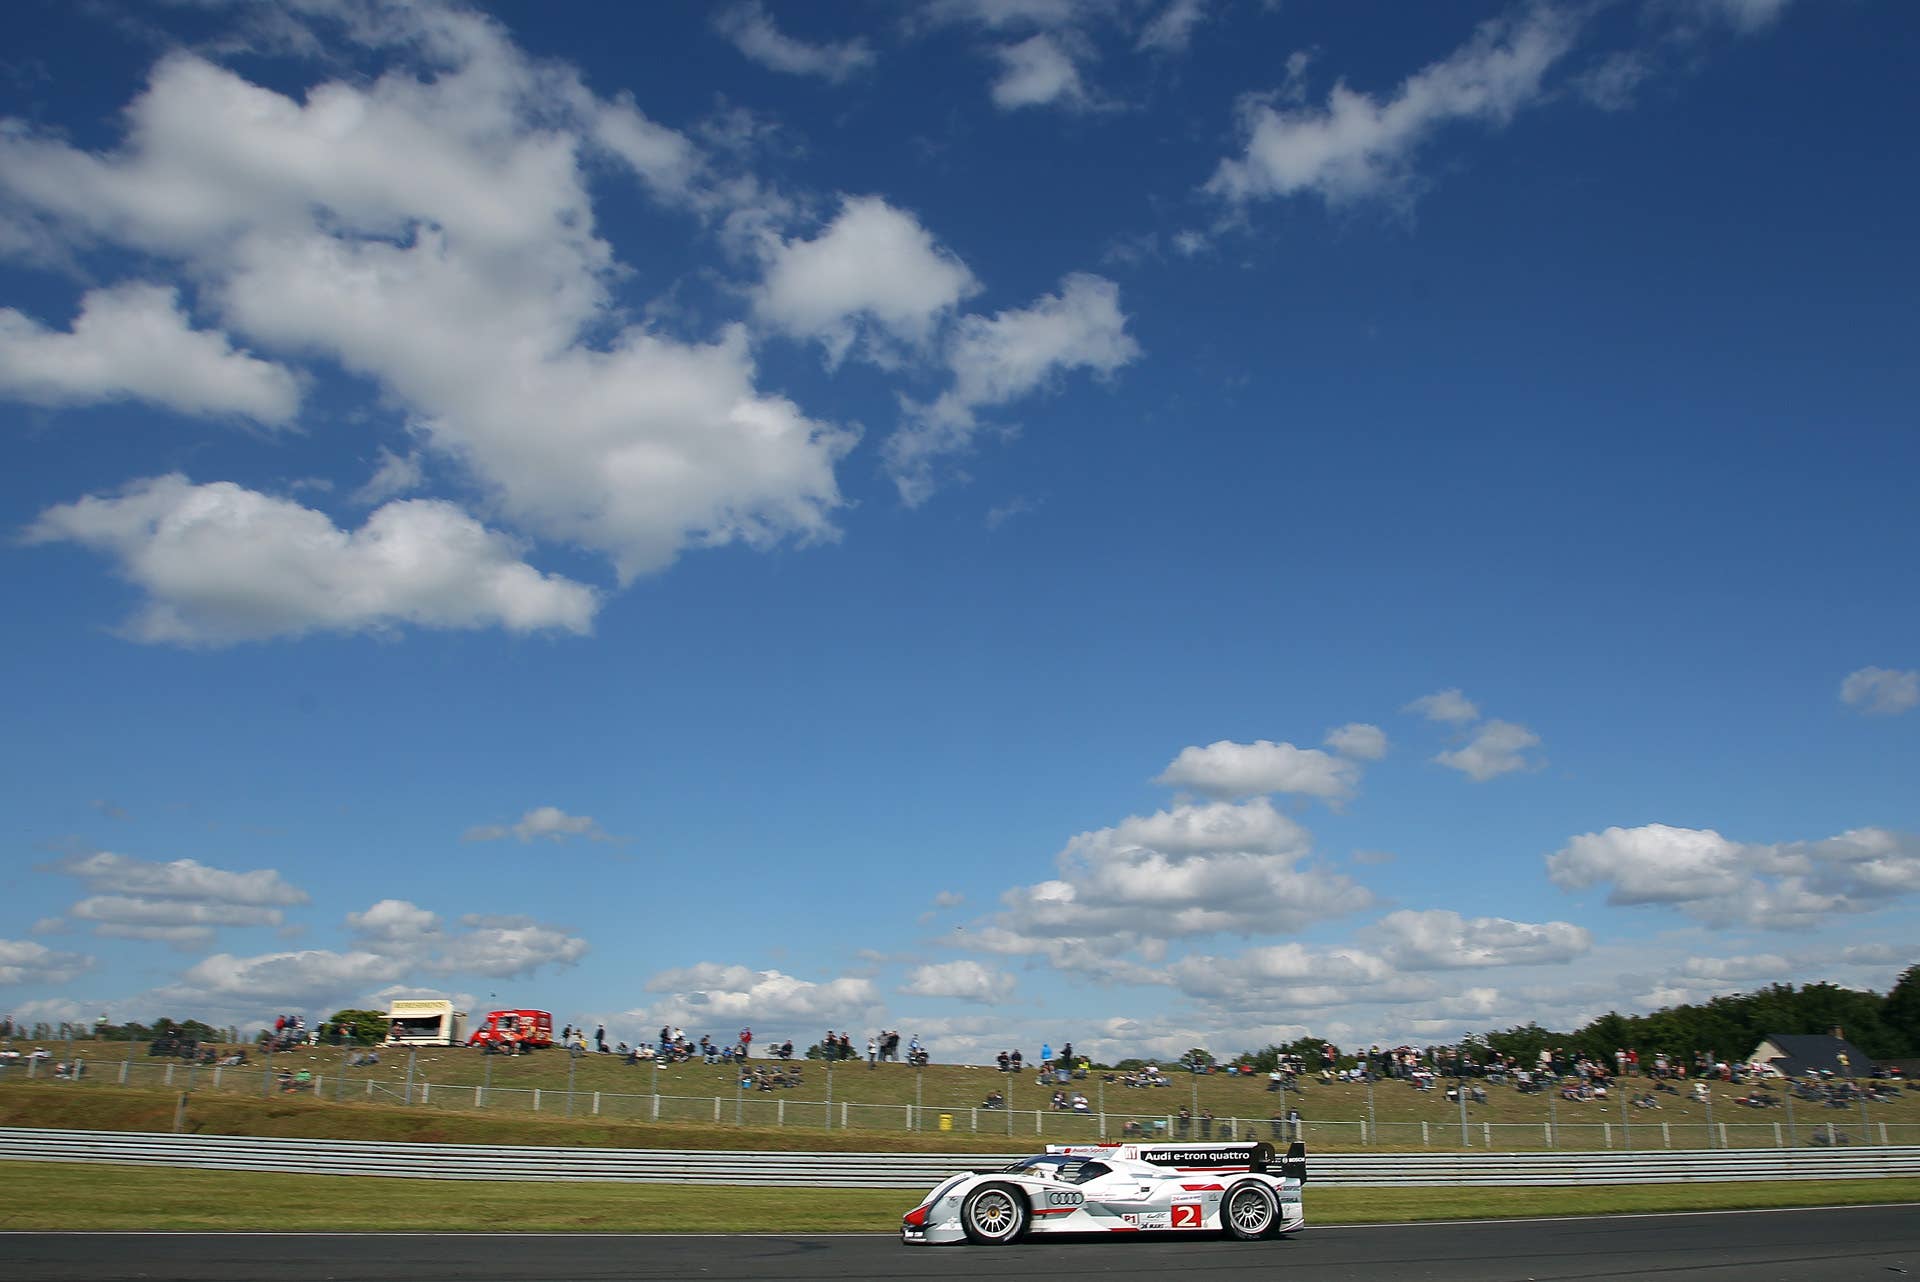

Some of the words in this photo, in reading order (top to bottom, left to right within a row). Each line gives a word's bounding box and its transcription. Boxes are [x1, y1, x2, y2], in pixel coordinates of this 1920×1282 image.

[1144, 1151, 1171, 1161] Audi
[1173, 1151, 1207, 1161] e-tron
[1209, 1151, 1250, 1162] quattro
[1124, 1215, 1136, 1224] P1
[1176, 1205, 1197, 1227] 2
